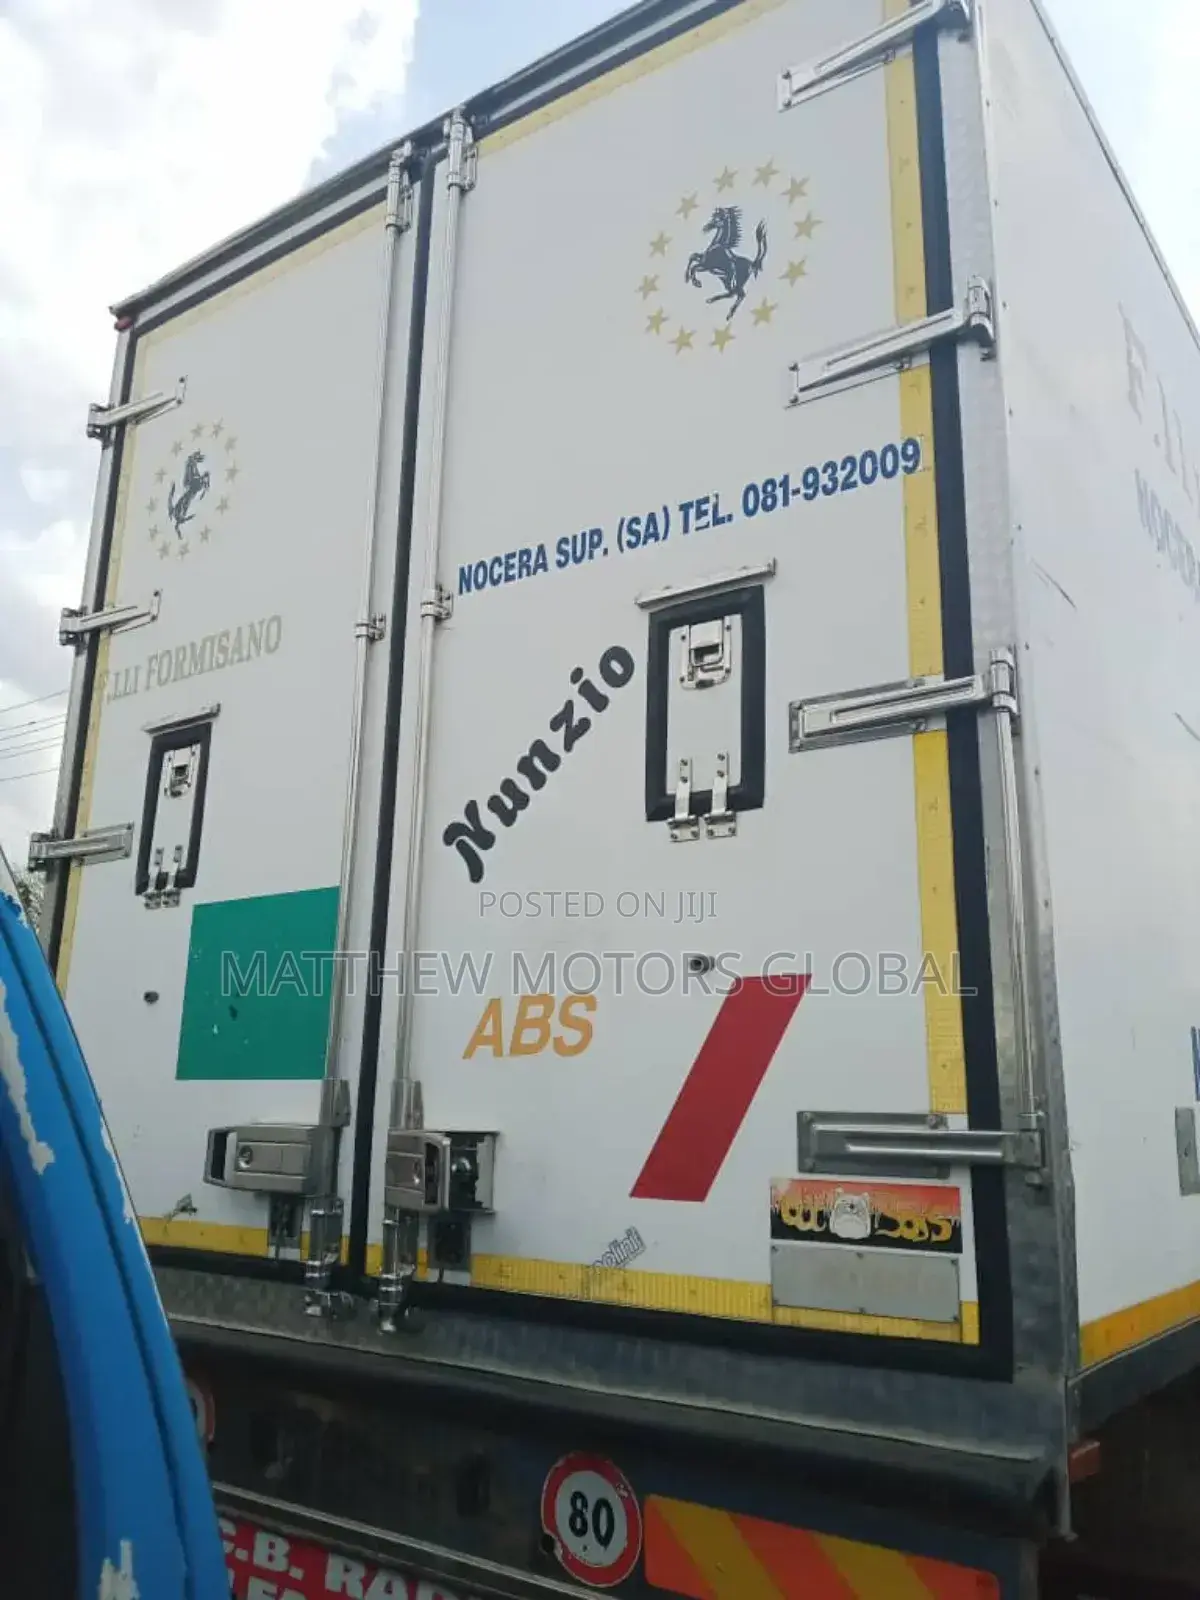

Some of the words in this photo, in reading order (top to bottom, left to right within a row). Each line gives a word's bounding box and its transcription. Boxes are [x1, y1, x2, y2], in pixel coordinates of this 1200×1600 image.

[458, 543, 549, 595] NOCERA
[555, 527, 609, 569] SUP.
[617, 504, 670, 554] (SA)
[678, 493, 733, 535] TEL.
[742, 437, 921, 518] 081-932009
[145, 614, 283, 689] FORMISANO
[443, 645, 635, 884] Nunzio
[462, 993, 598, 1060] ABS
[568, 1490, 616, 1550] 80
